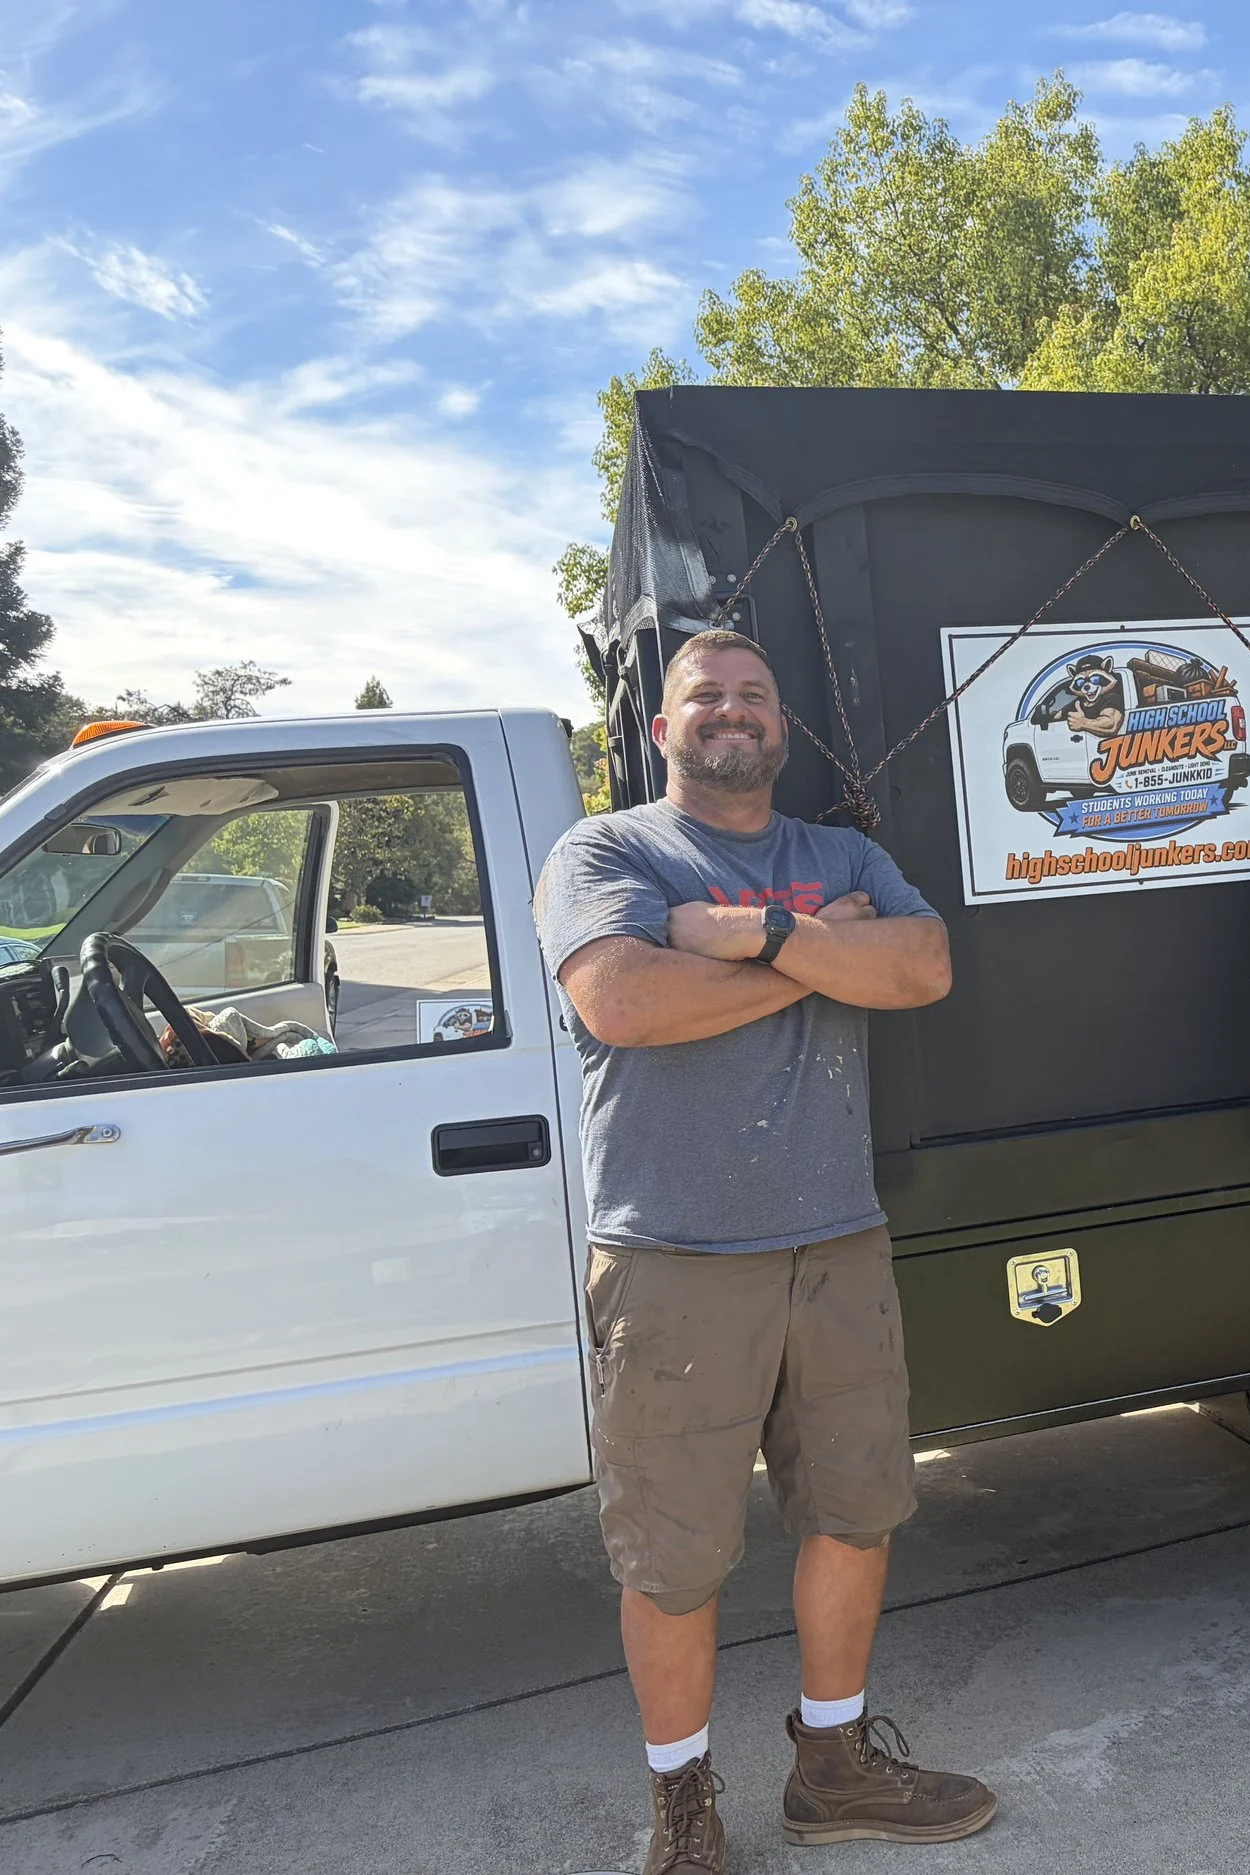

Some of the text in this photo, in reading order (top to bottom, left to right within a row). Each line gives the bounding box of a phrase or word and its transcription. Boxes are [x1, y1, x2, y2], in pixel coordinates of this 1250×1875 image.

[1126, 699, 1227, 732] HIGH SCHOOL
[1090, 720, 1237, 783] JUNKERS LLC
[1134, 768, 1213, 789] 1-855-JUNKKID
[1161, 764, 1184, 772] CLEANOUTS
[1081, 788, 1208, 814] STUDENTS WORKING TODAY
[1082, 801, 1209, 828] FOR A BETTER TOMORROW
